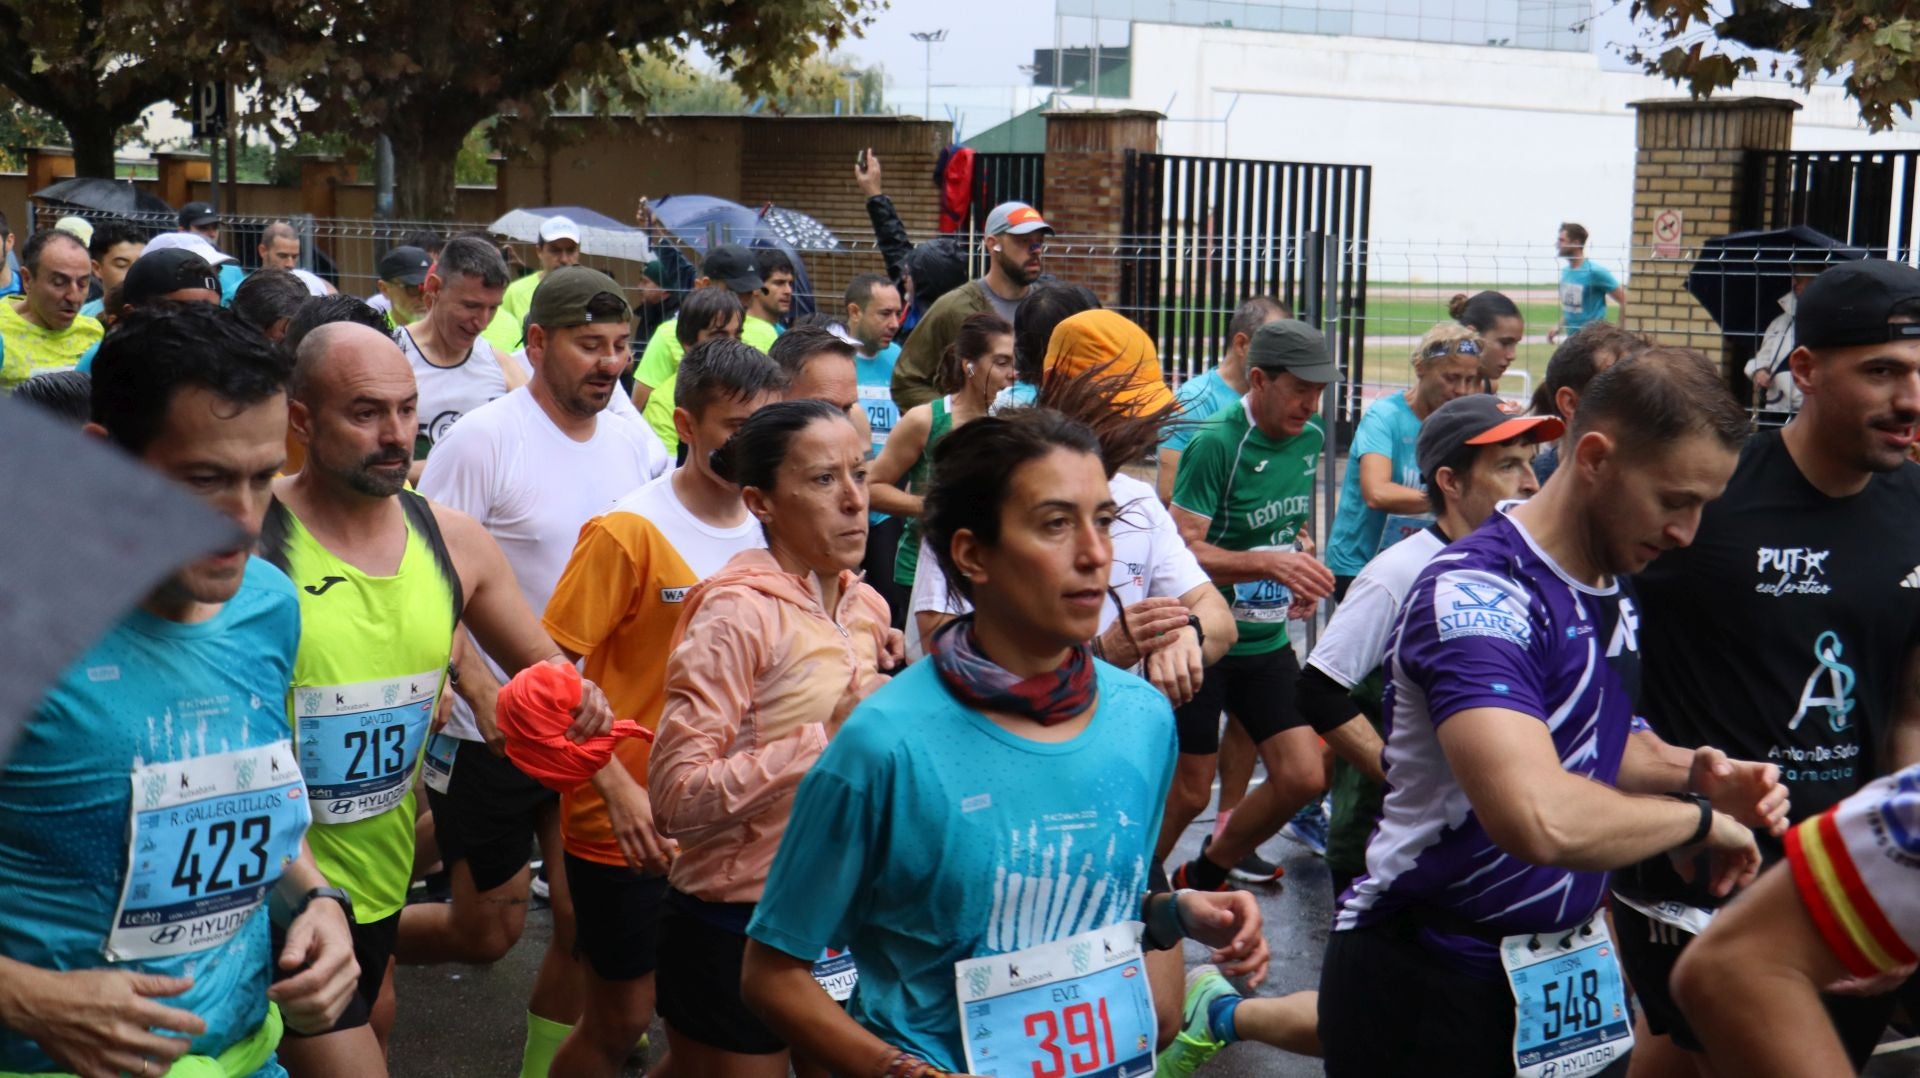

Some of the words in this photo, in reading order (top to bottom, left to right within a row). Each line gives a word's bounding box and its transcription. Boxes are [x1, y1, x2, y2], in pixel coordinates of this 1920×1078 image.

[868, 406, 890, 427] 291
[360, 713, 393, 727] DAVID
[344, 724, 405, 781] 213
[171, 815, 271, 897] 423
[1052, 985, 1080, 1003] EVI
[1542, 969, 1602, 1041] 548
[1023, 997, 1115, 1078] 391
[1562, 1046, 1615, 1073] HYUNDAI
